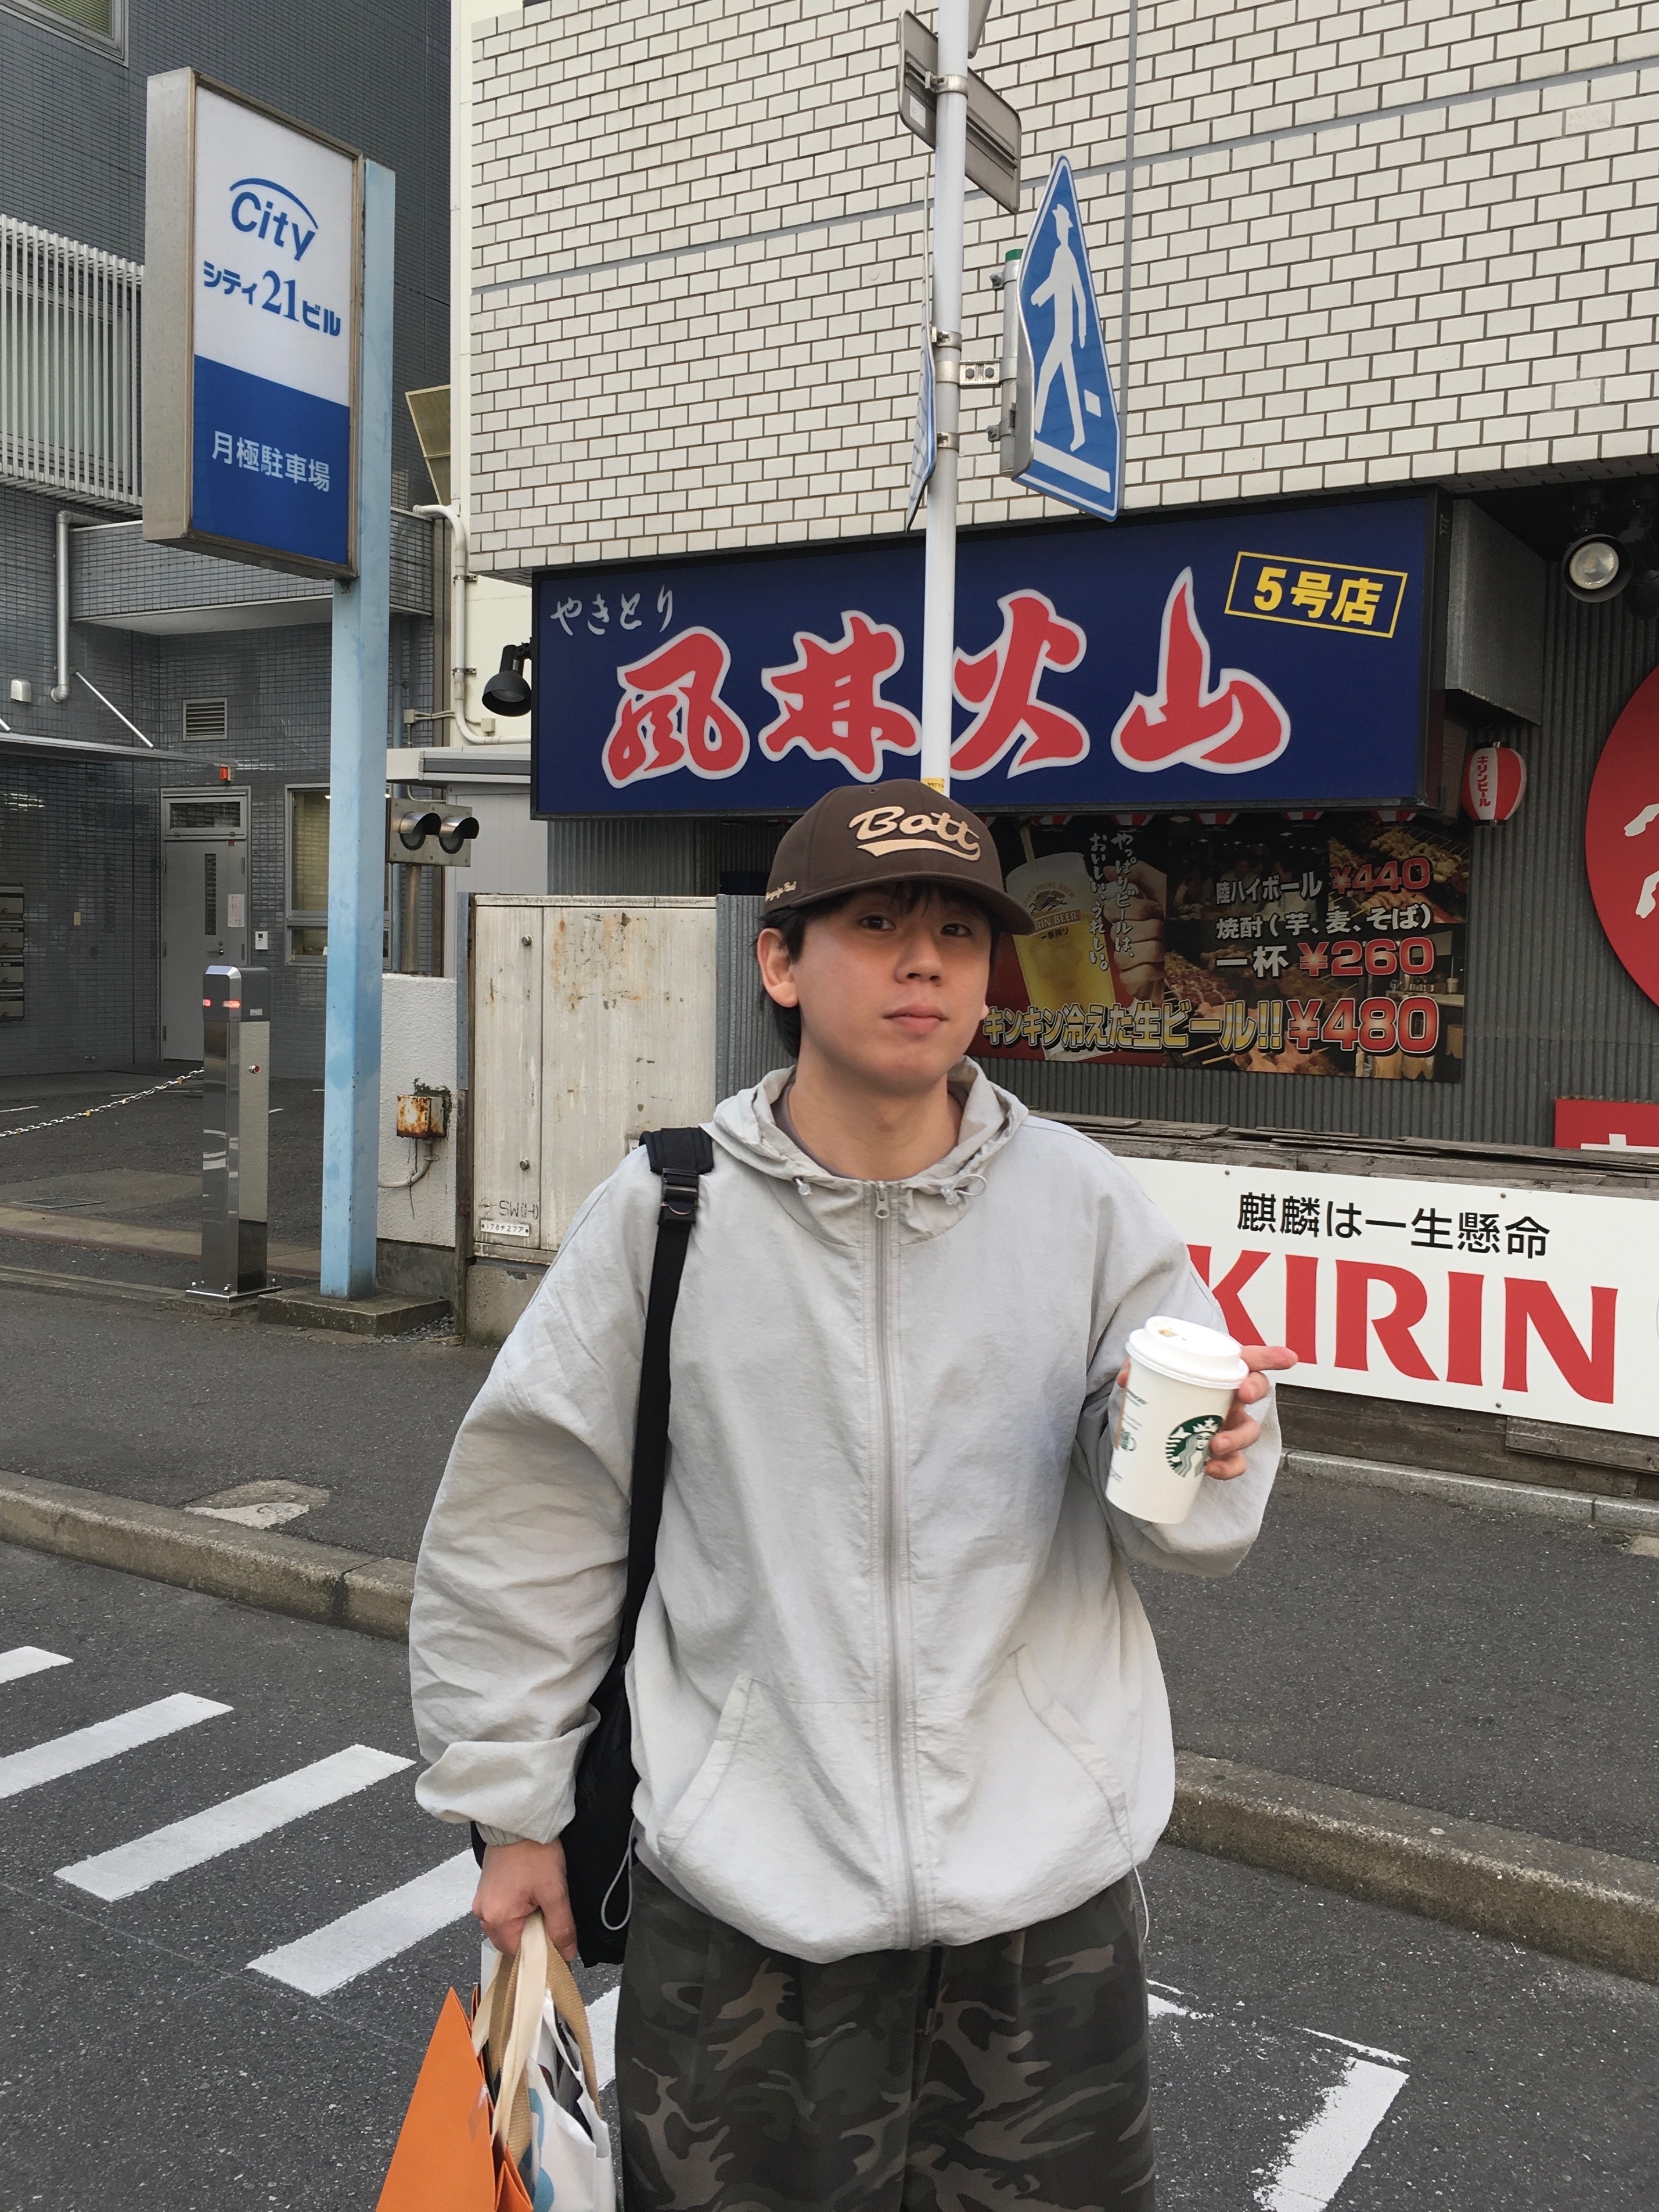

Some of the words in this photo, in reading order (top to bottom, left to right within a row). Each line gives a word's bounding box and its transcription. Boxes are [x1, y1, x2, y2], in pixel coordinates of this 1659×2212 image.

[231, 192, 316, 261] City
[203, 261, 341, 337] シティ21ビル
[211, 430, 331, 492] 月極駐車場
[550, 585, 673, 636] やきとり
[1253, 566, 1384, 625] 5号店
[602, 566, 1291, 789] 風林火山
[1477, 756, 1491, 807] キリンビール
[1216, 871, 1323, 905] 陸ハイボール
[1330, 857, 1430, 894] ¥440
[1054, 912, 1078, 924] BEER
[1216, 945, 1289, 978] 一杯
[1297, 937, 1435, 977] ¥260
[1287, 996, 1440, 1053] ¥480
[1237, 1192, 1550, 1259] 麒麟は一生懸命
[1186, 1244, 1618, 1405] KIRIN
